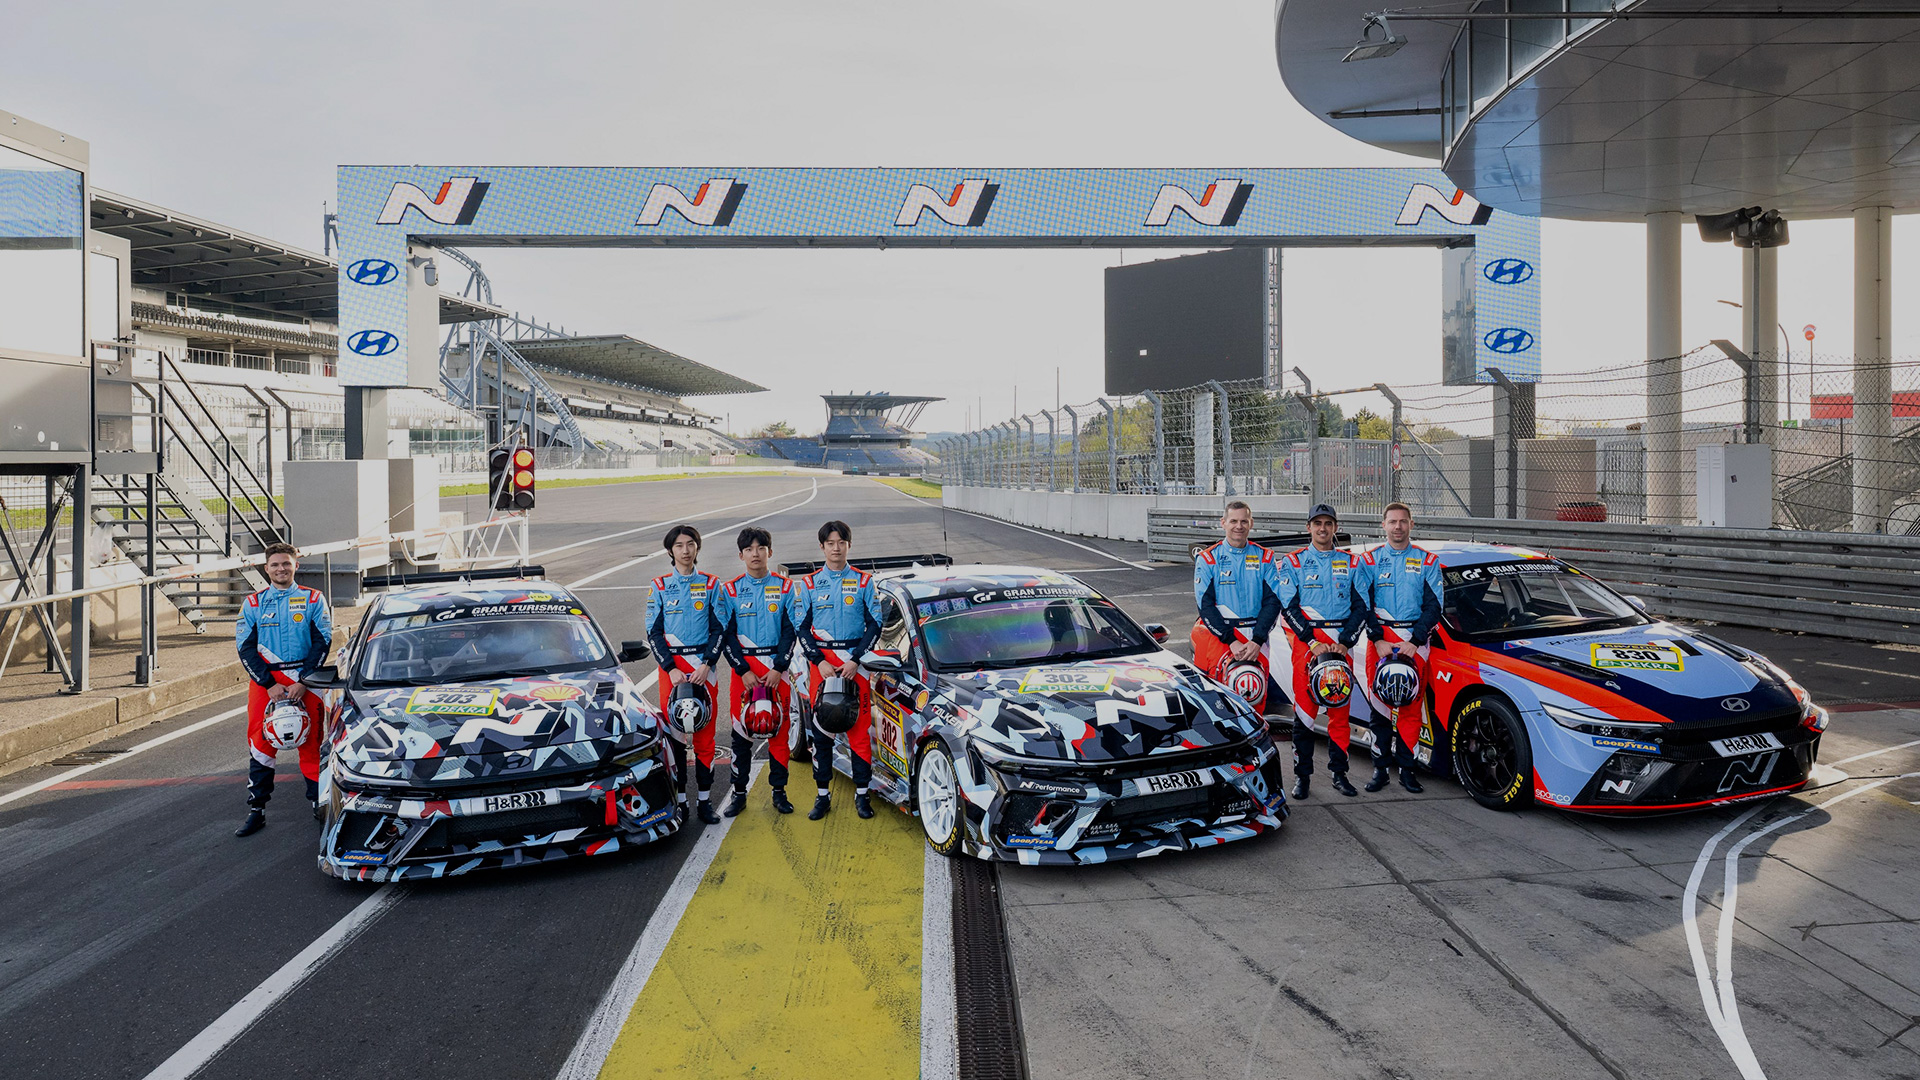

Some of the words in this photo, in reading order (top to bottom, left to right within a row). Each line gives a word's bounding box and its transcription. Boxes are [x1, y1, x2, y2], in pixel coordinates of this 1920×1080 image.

[1487, 564, 1516, 574] GRAN
[1516, 563, 1560, 571] TURISMO
[1003, 588, 1035, 597] GRAN
[1038, 587, 1087, 596] TURISMO
[471, 605, 508, 615] GRAN
[511, 604, 567, 612] TURISMO
[1611, 649, 1661, 660] 830
[1619, 660, 1675, 670] DEKRA
[1044, 673, 1089, 683] 302
[429, 693, 477, 704] 303
[437, 706, 486, 714] DEKRA
[881, 717, 898, 752] 302
[1595, 738, 1657, 752] GOODYEAR
[1724, 737, 1754, 752] H&R
[1149, 775, 1184, 793] H&R
[1503, 772, 1524, 803] EAGLE
[1535, 788, 1571, 802] sparco
[485, 797, 523, 812] H&R
[1009, 836, 1055, 847] GOODYEAR
[343, 854, 383, 863] GOODYEAR
